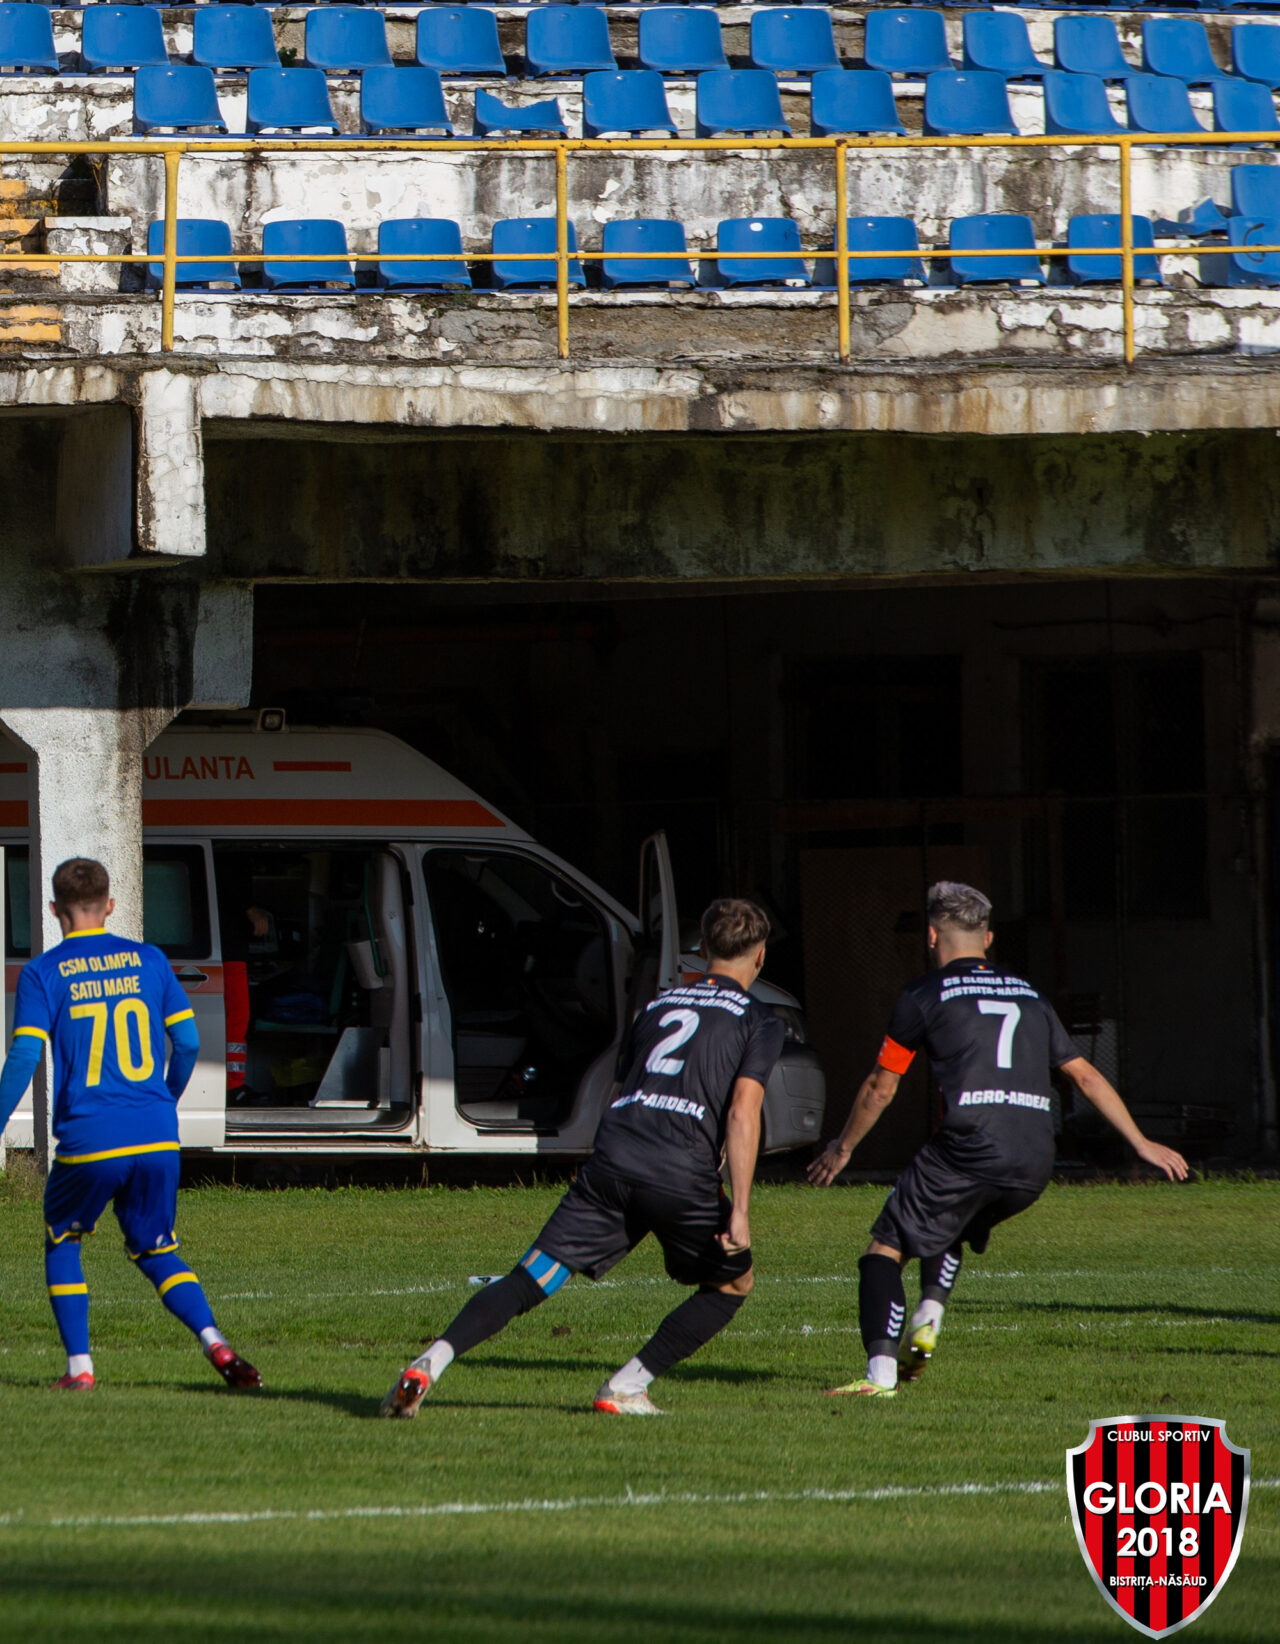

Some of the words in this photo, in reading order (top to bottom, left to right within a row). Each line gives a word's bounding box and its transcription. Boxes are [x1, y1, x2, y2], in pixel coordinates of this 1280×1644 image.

[143, 755, 256, 780] ULANTA
[58, 957, 89, 977] CSM
[88, 951, 142, 972] OLIMPIA
[70, 980, 102, 1001] SATU
[103, 975, 141, 997] MARE
[962, 975, 1003, 985] GLORIA
[69, 998, 155, 1087] 70
[645, 1008, 700, 1076] 2
[977, 1000, 1021, 1069] 7
[610, 1088, 706, 1120] -ARDEAL
